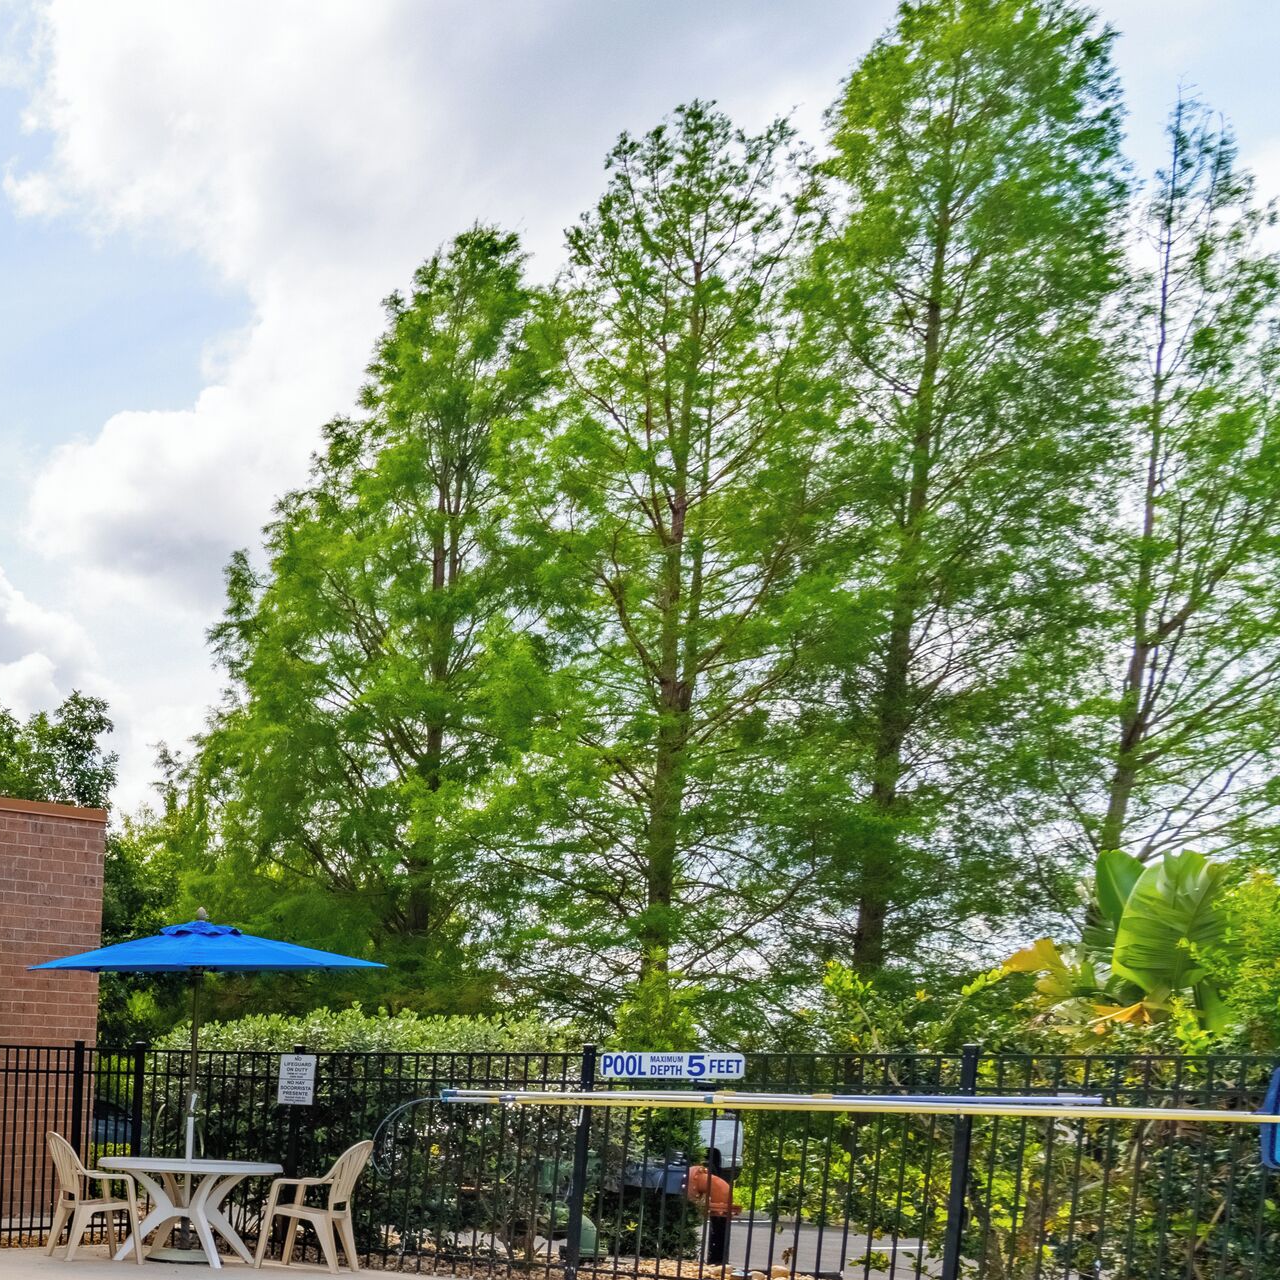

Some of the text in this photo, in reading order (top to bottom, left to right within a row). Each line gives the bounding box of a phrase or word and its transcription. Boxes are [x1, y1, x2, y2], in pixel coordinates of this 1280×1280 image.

[602, 1055, 646, 1076] POOL
[650, 1065, 682, 1075] DEPTH
[687, 1055, 742, 1076] 5 FEET
